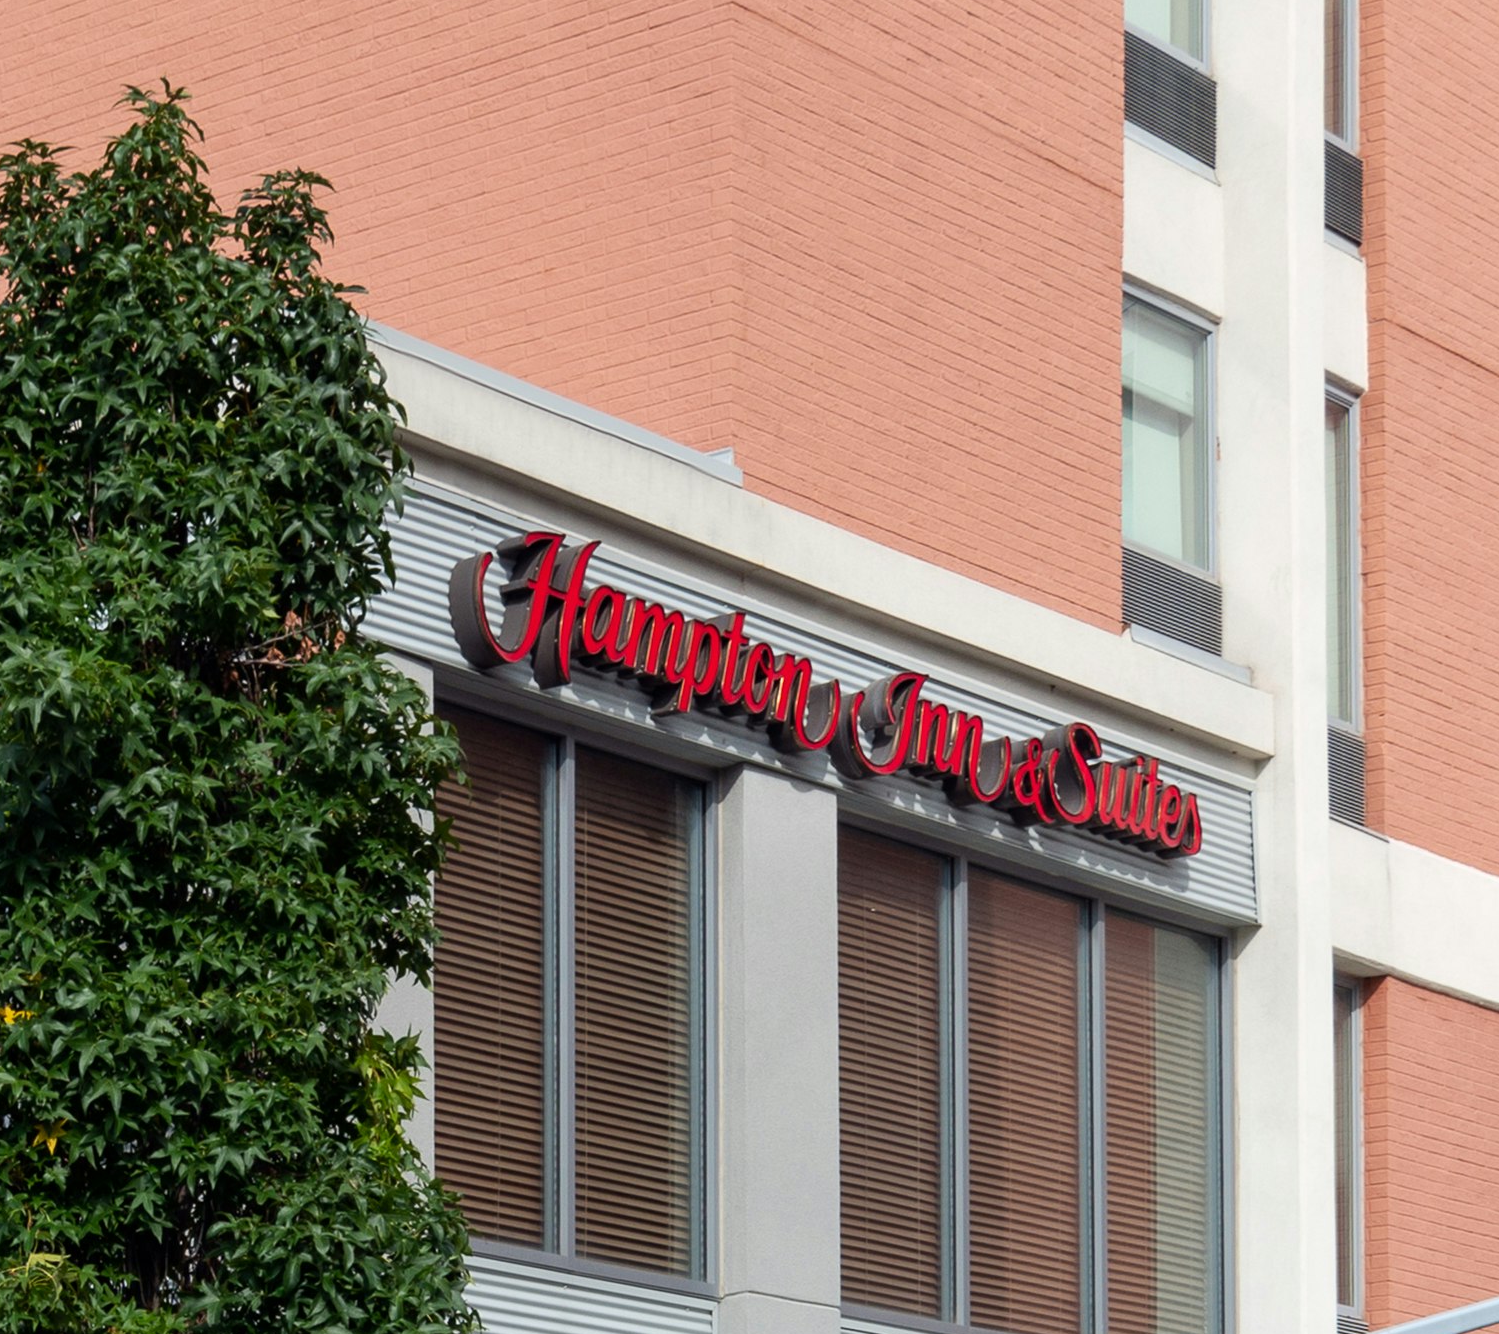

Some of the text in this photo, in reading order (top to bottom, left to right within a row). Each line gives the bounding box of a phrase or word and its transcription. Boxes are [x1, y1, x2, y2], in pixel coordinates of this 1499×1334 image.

[470, 530, 1202, 856] Hampton Inn & Suites
